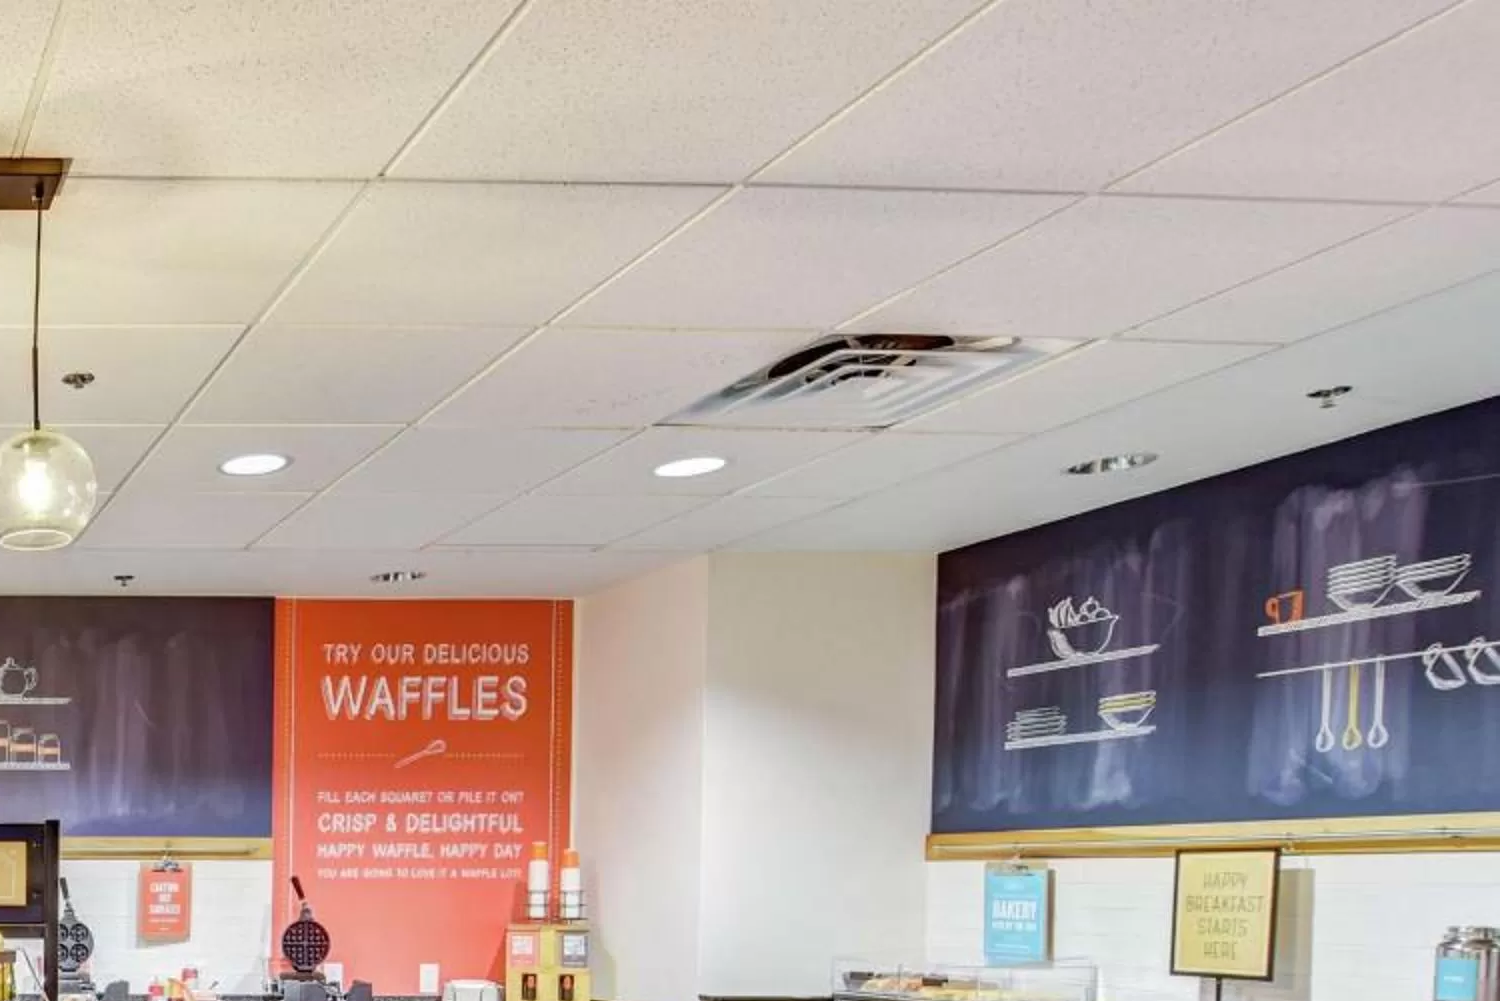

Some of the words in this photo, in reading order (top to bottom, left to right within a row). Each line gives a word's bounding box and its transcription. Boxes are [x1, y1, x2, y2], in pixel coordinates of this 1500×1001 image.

[323, 643, 362, 665] TRY
[371, 643, 415, 665] OUR
[423, 643, 530, 665] DELICIOUS
[320, 674, 528, 721] WAFFLES
[316, 791, 341, 803] FILL
[345, 791, 375, 803] EACH
[437, 791, 455, 803] OR
[457, 791, 483, 803] PILE
[486, 791, 497, 803] IT
[317, 812, 377, 834] CRISP
[385, 812, 397, 833] &
[406, 812, 524, 835] DELIGHTFUL
[316, 843, 365, 859] HAPPY
[440, 843, 488, 859] HAPPY
[494, 843, 522, 860] DAY
[317, 868, 337, 880] YOU
[1203, 870, 1249, 890] HAPPY
[992, 899, 1037, 921] BAKERY
[1185, 894, 1265, 913] BREAKFAST
[1197, 916, 1250, 938] STARTS
[1203, 940, 1238, 960] HERE
